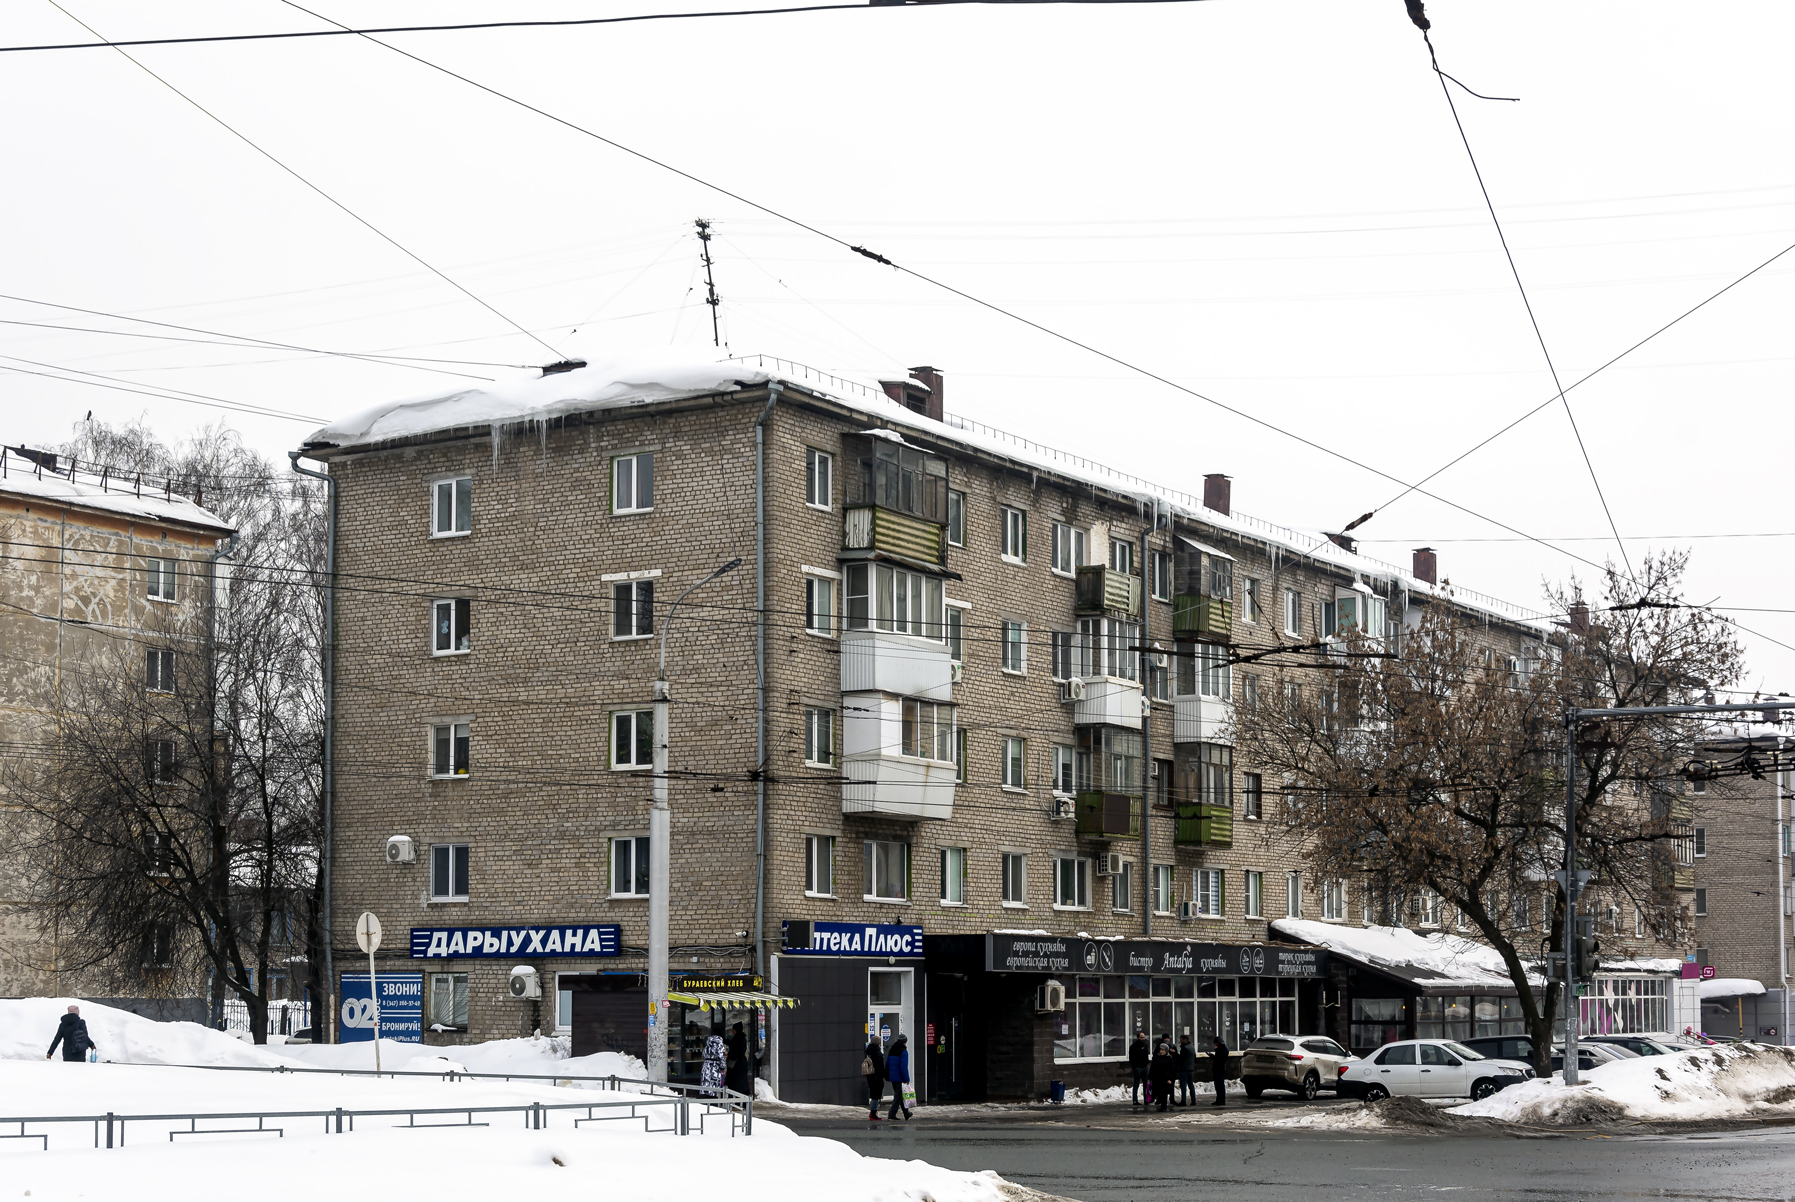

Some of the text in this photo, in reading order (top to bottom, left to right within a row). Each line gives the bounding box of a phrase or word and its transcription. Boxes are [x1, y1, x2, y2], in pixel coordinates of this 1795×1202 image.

[427, 929, 602, 957] ДАРЫУХАНА
[797, 932, 861, 951] птека
[1012, 941, 1035, 955] европа
[1006, 955, 1069, 970] европейская кухня
[1129, 951, 1153, 971] бистро
[1161, 951, 1193, 974] Antalya
[382, 983, 421, 996] ЗВОНИ!
[683, 978, 725, 988] БУРАЕВСКИЙ
[382, 1021, 421, 1031] БРОНИРУЙ!
